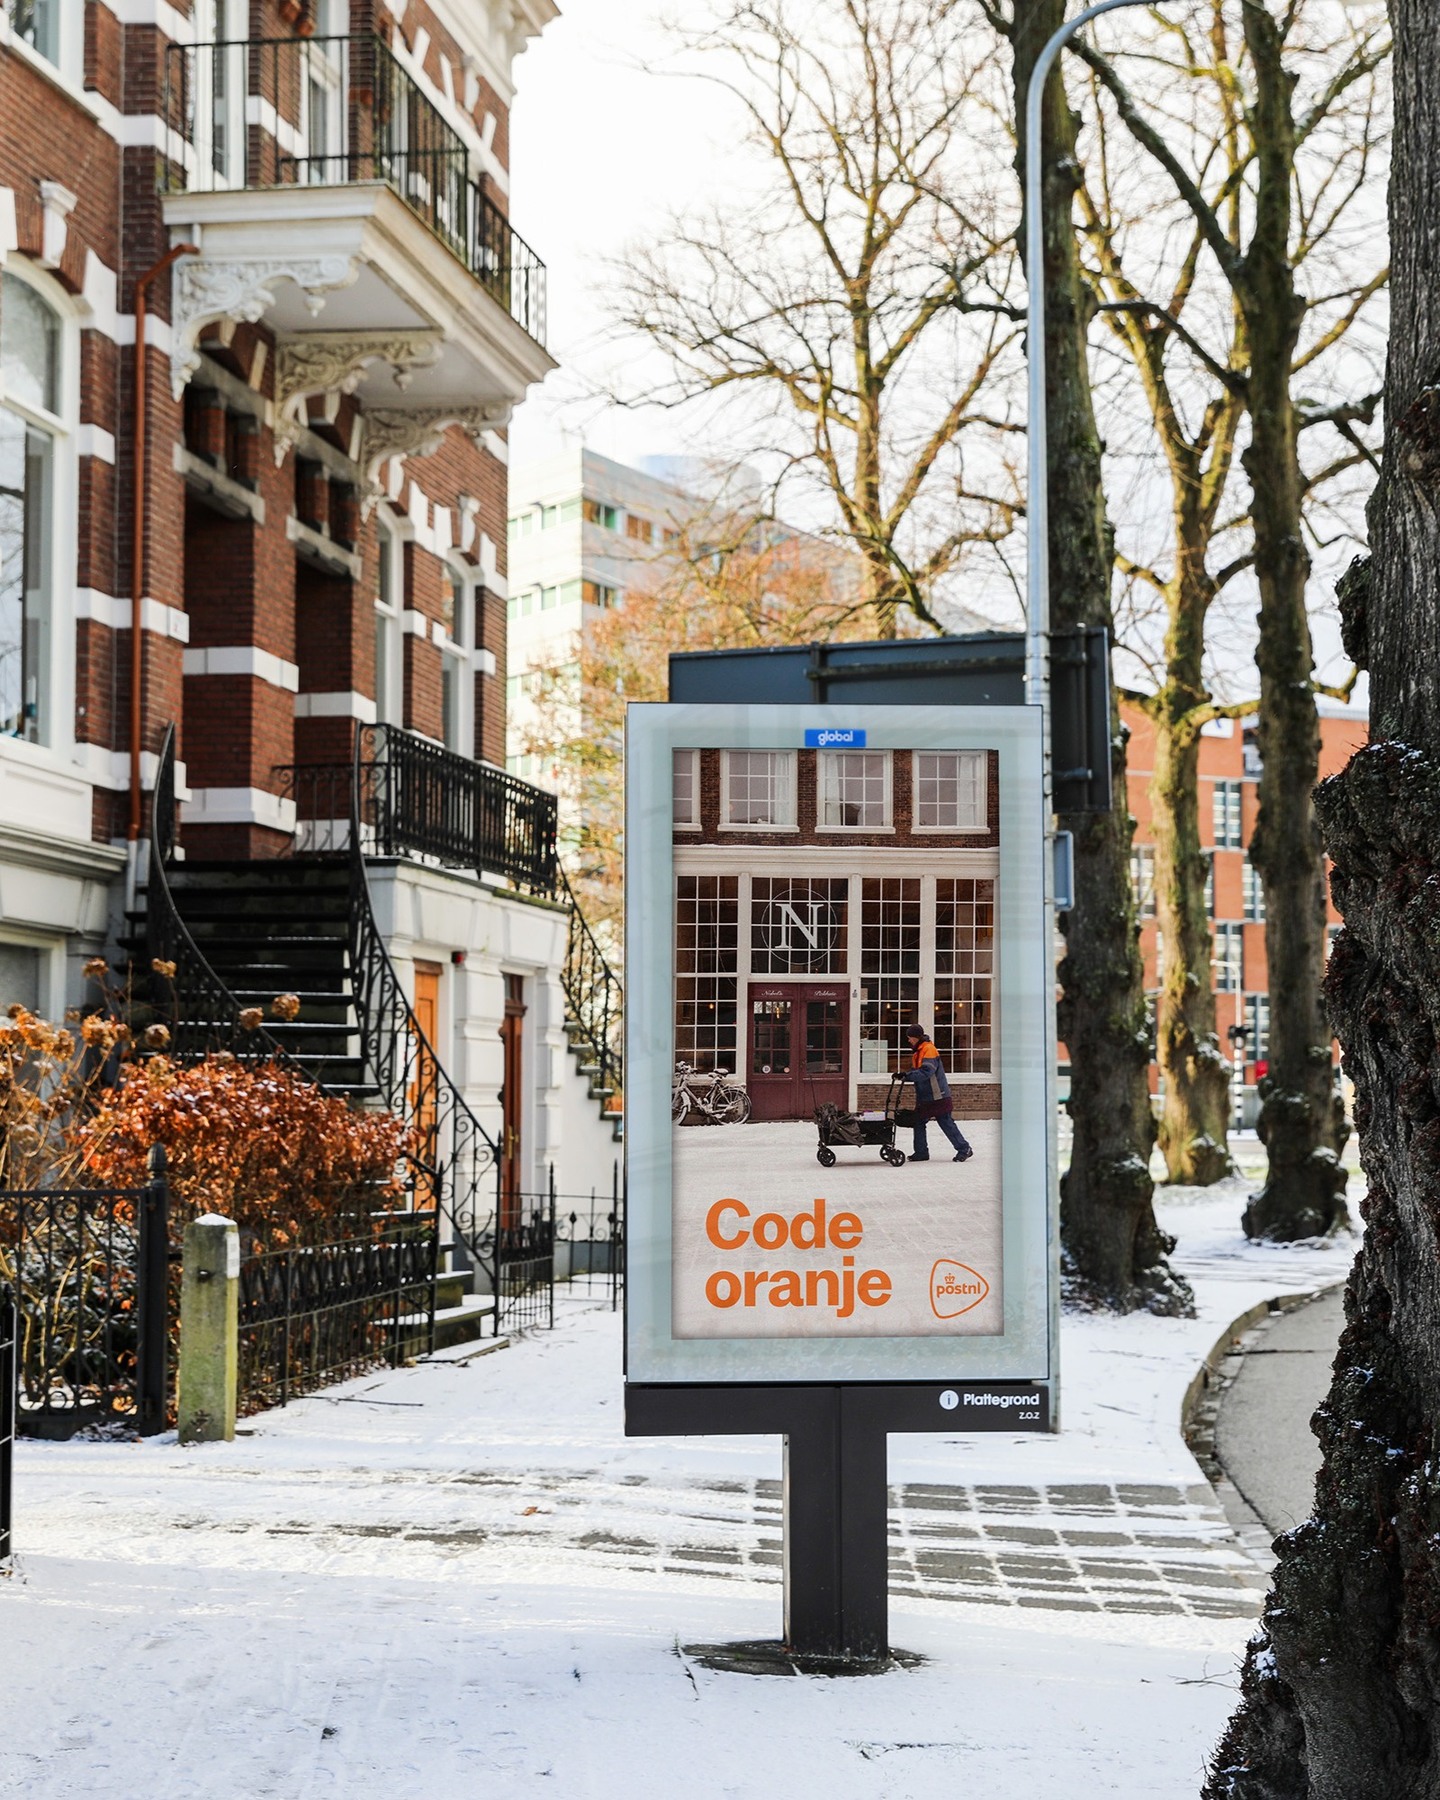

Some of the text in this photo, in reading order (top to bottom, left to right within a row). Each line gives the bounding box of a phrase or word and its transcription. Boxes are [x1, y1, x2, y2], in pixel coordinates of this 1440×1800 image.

[818, 730, 854, 746] global
[775, 903, 825, 949] N
[705, 1198, 863, 1250] Code
[705, 1256, 892, 1318] oranje
[936, 1281, 981, 1298] postnl
[963, 1393, 1040, 1409] Plattegrond
